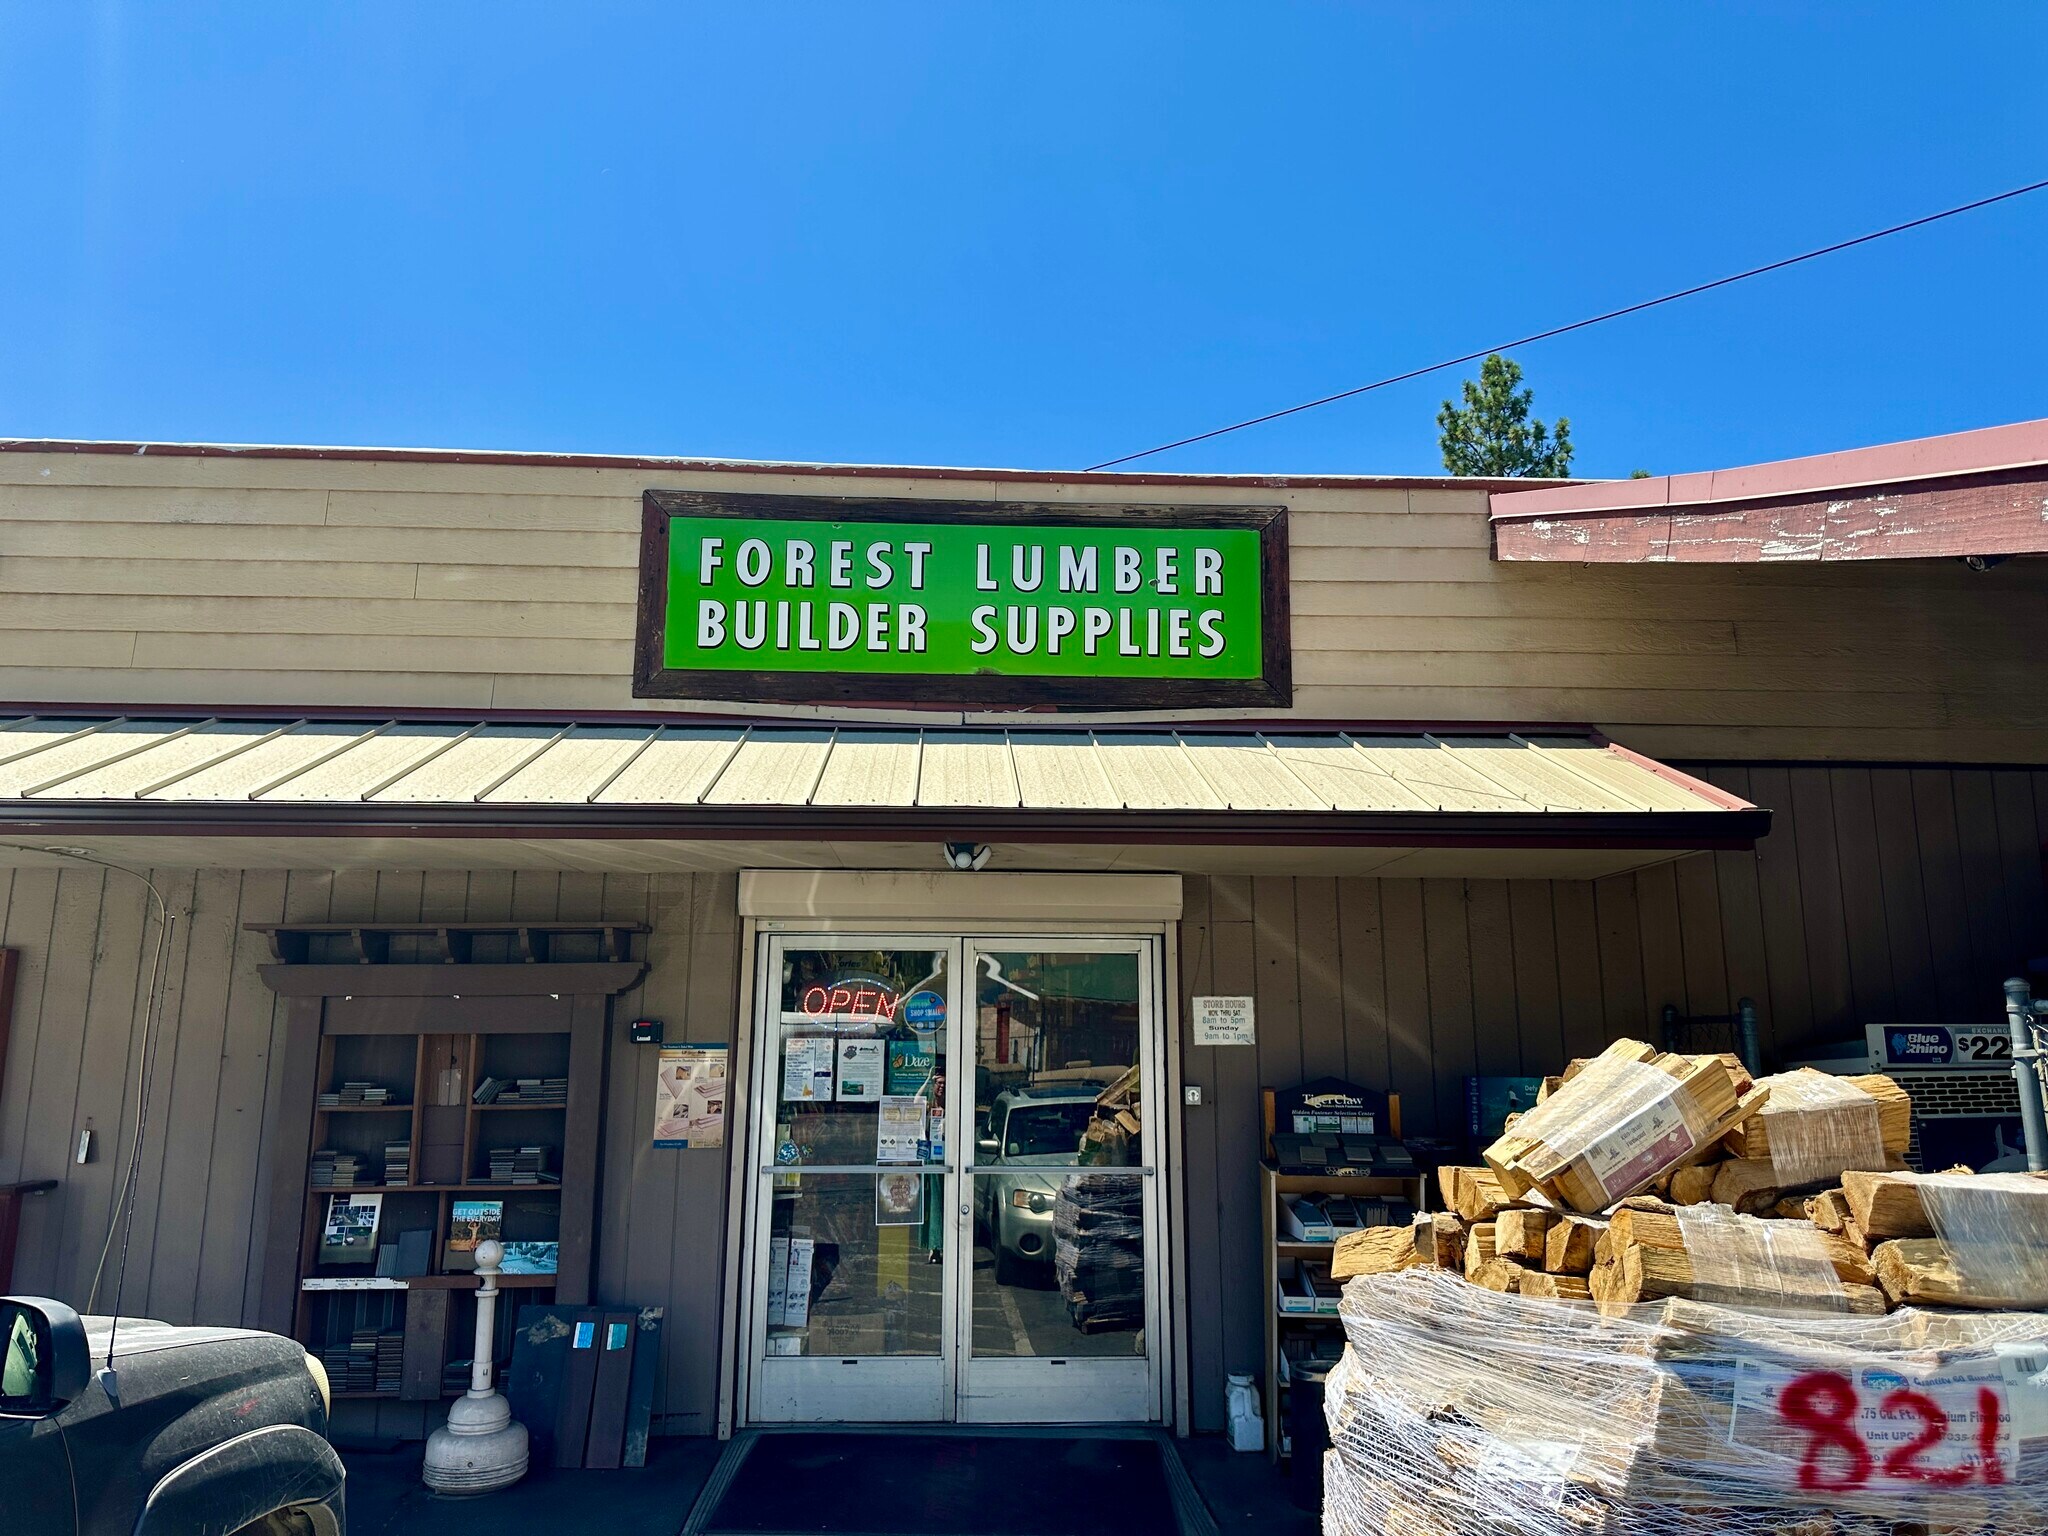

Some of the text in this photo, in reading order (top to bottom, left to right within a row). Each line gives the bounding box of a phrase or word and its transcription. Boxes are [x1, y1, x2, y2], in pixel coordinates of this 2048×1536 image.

[700, 537, 1224, 596] FOREST LUMBER
[697, 599, 1226, 658] BUILDER SUPPLIES
[804, 987, 899, 1021] OPEN
[1203, 1000, 1246, 1008] STORE HOURS
[925, 1008, 941, 1016] SMALL
[1231, 1017, 1245, 1025] 5pm
[1205, 1032, 1219, 1040] 9am
[1908, 1033, 1939, 1044] Blue
[1906, 1043, 1948, 1054] Rhino
[1958, 1036, 2012, 1060] $22
[904, 1053, 930, 1067] Daze
[452, 1208, 501, 1216] GET OUTSIDE
[1914, 1376, 1952, 1387] Quantity
[1861, 1408, 1877, 1419] .75
[1880, 1408, 1897, 1420] Cu.
[1899, 1409, 1915, 1420] Ft.
[1779, 1371, 2004, 1491] 821
[1866, 1431, 1889, 1440] Unit
[1892, 1431, 1915, 1441] UPC
